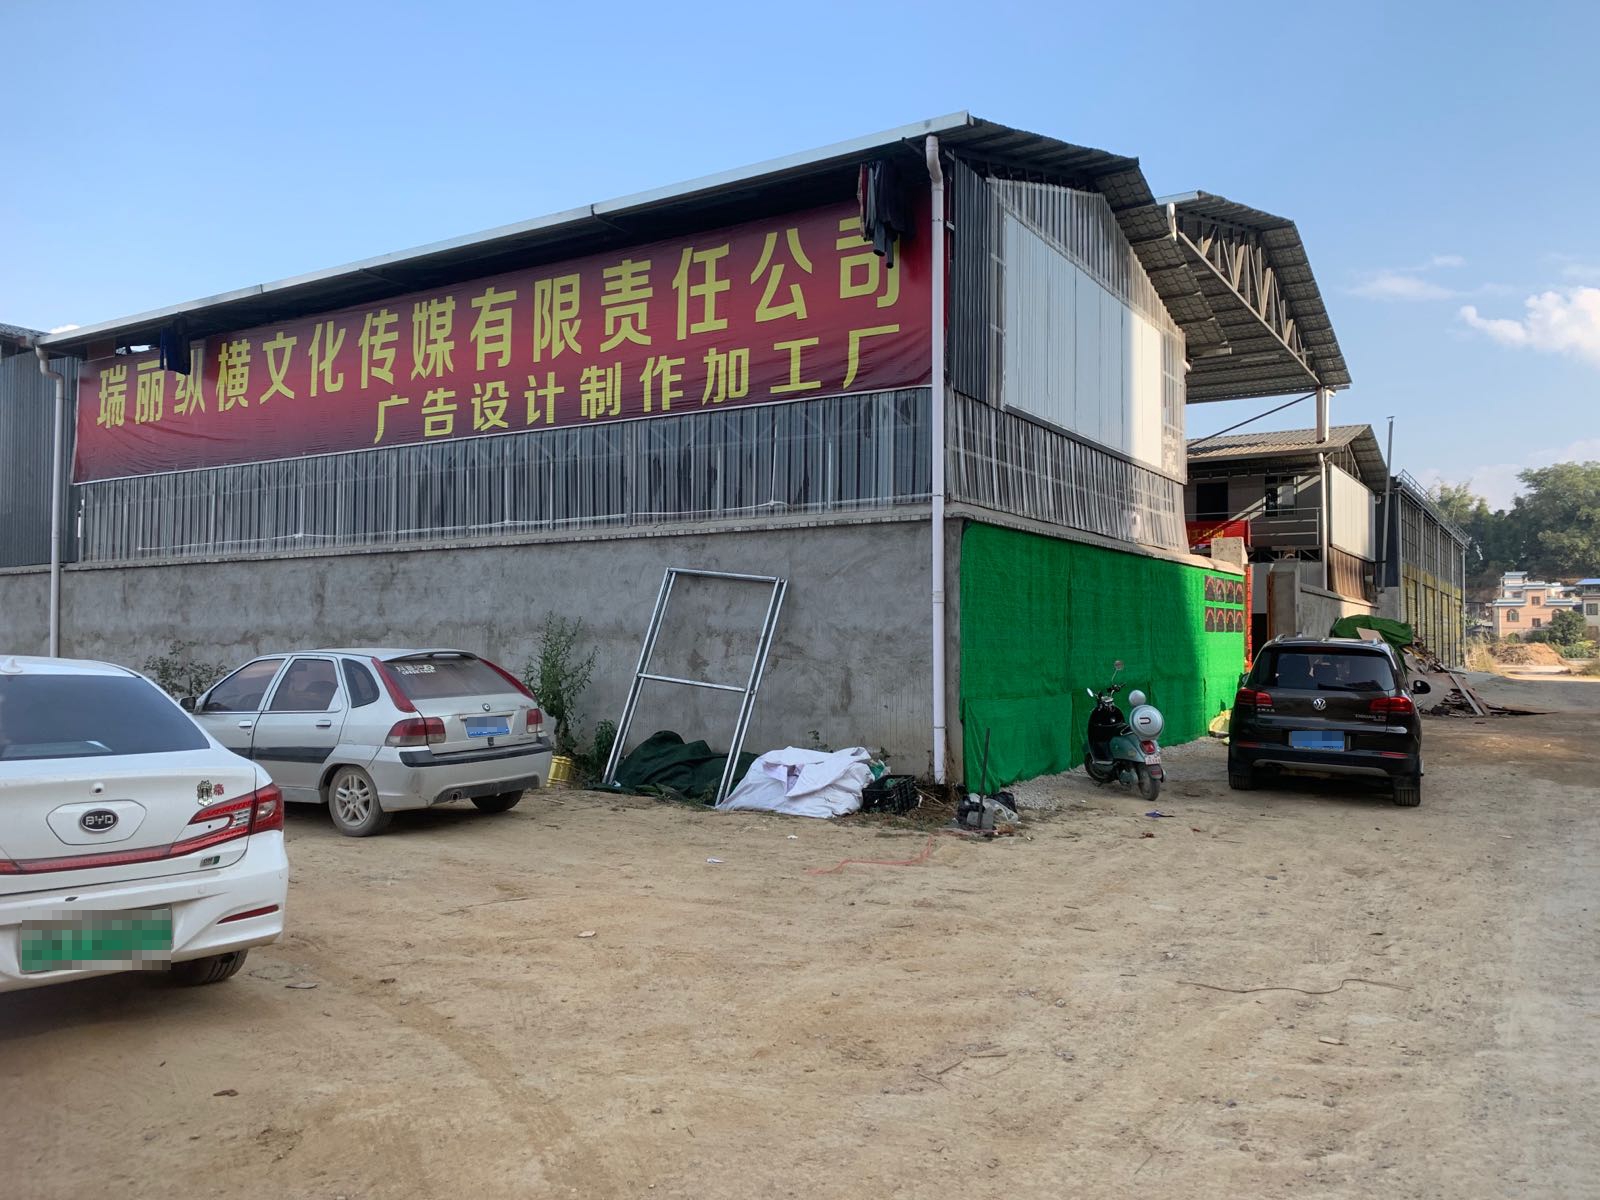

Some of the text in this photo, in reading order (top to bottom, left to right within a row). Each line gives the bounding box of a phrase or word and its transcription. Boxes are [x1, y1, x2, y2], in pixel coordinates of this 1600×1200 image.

[97, 215, 901, 429] 瑞丽纵横文化传媒有限责任公司
[373, 323, 901, 443] 广告设计制作加工厂
[85, 814, 114, 826] BYD
